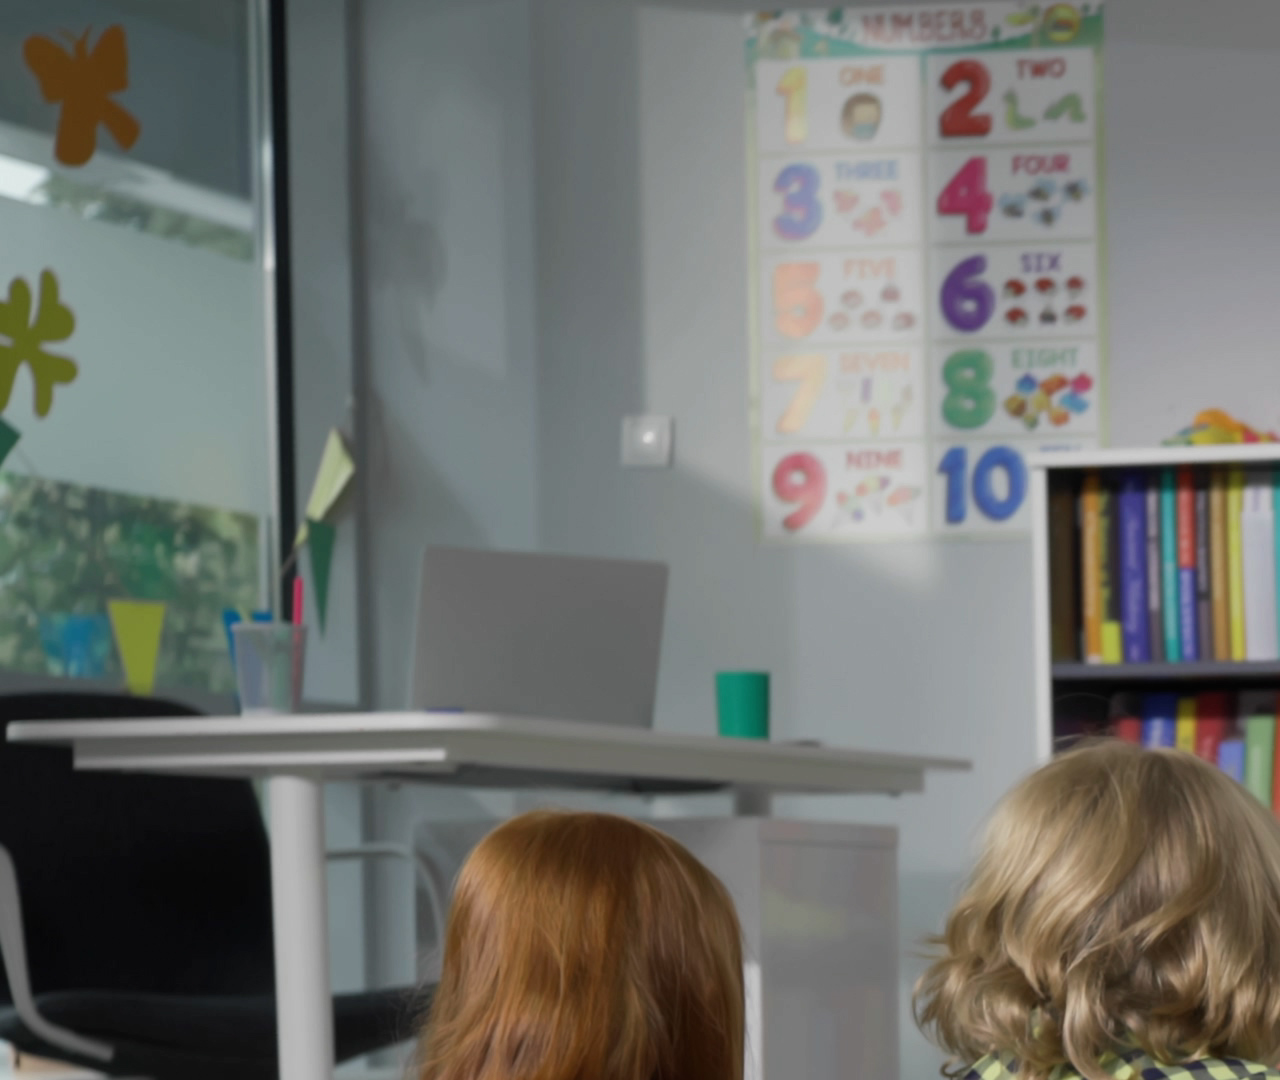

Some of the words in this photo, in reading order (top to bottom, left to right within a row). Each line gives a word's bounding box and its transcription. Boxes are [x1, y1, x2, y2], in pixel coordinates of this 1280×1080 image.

[775, 66, 808, 144] 1
[839, 65, 886, 87] ONE
[938, 58, 992, 138] 2
[1016, 58, 1066, 80] TWO
[772, 163, 822, 241] 3
[834, 160, 898, 182] THREE
[936, 157, 992, 234] 4
[1011, 154, 1071, 176] FOUR
[772, 262, 824, 338] 5
[843, 259, 896, 281] FIVE
[938, 254, 996, 332] 6
[1021, 253, 1061, 273] SIX
[772, 352, 828, 434] 7
[941, 348, 997, 430] 8
[1011, 348, 1078, 369] EIGHT
[772, 452, 827, 531] 9
[845, 450, 903, 471] NINE
[938, 445, 1028, 524] 10
